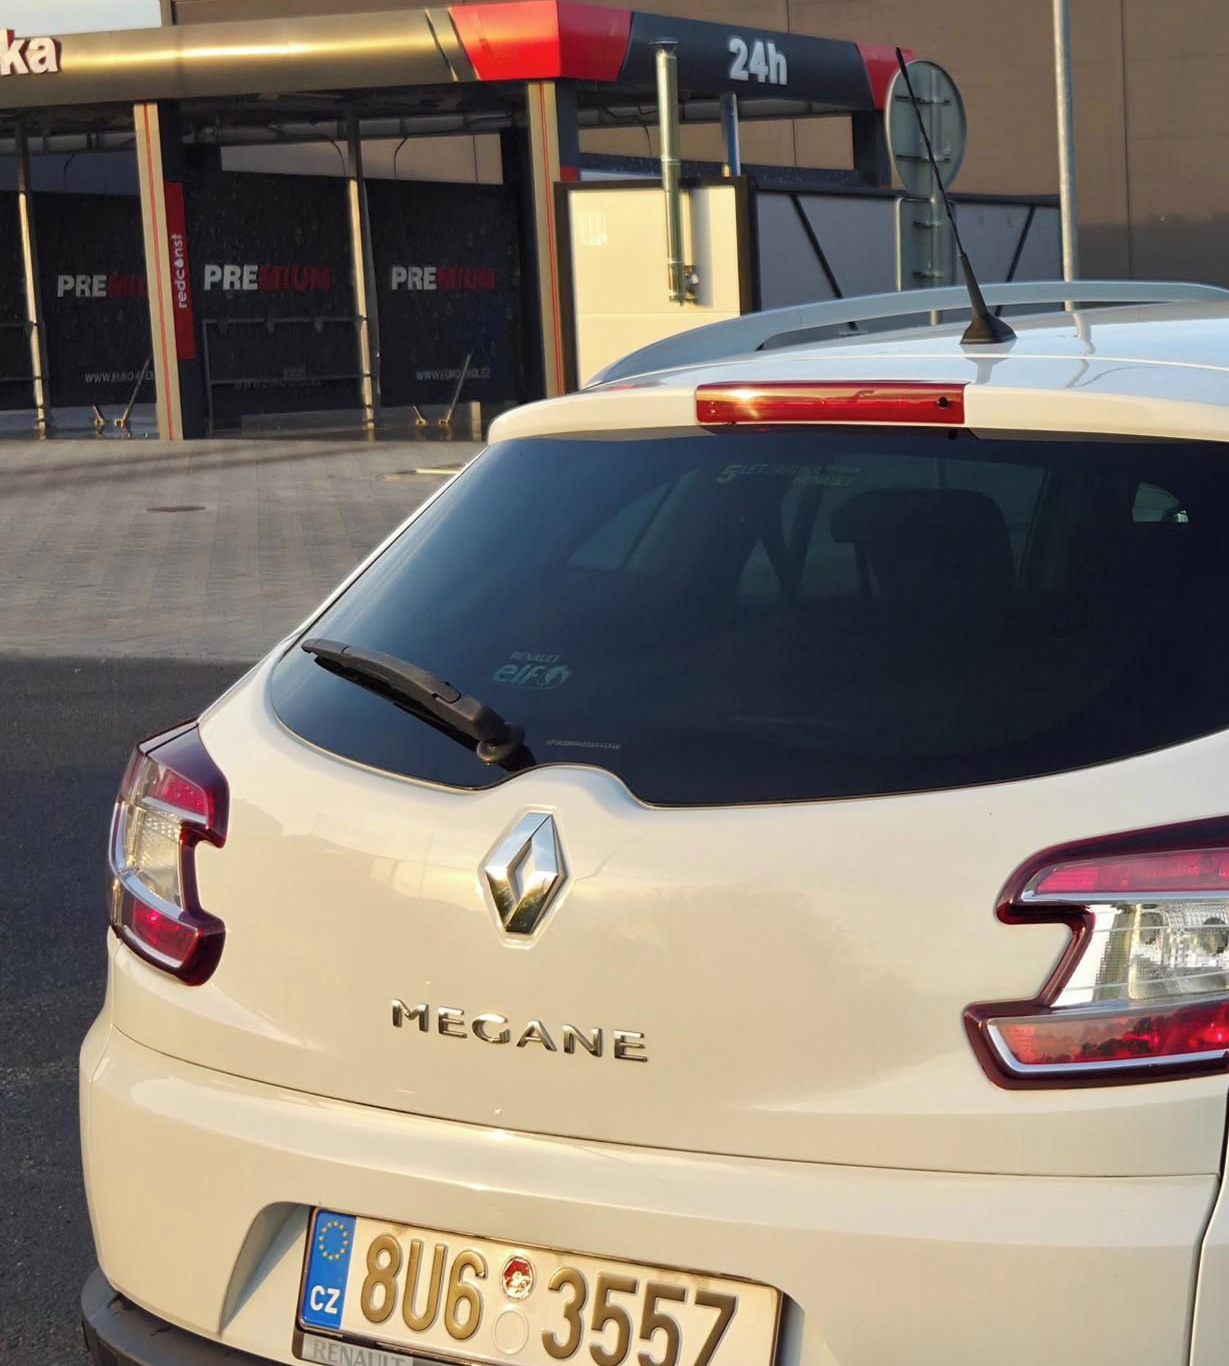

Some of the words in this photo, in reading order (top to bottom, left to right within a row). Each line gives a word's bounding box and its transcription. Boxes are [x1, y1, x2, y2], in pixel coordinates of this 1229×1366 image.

[729, 37, 787, 84] 24h
[57, 273, 147, 298] PREMI
[204, 264, 331, 291] PREMIUM
[391, 998, 648, 1062] MEGANE
[309, 1284, 339, 1316] CZ
[360, 1234, 487, 1341] 8U6
